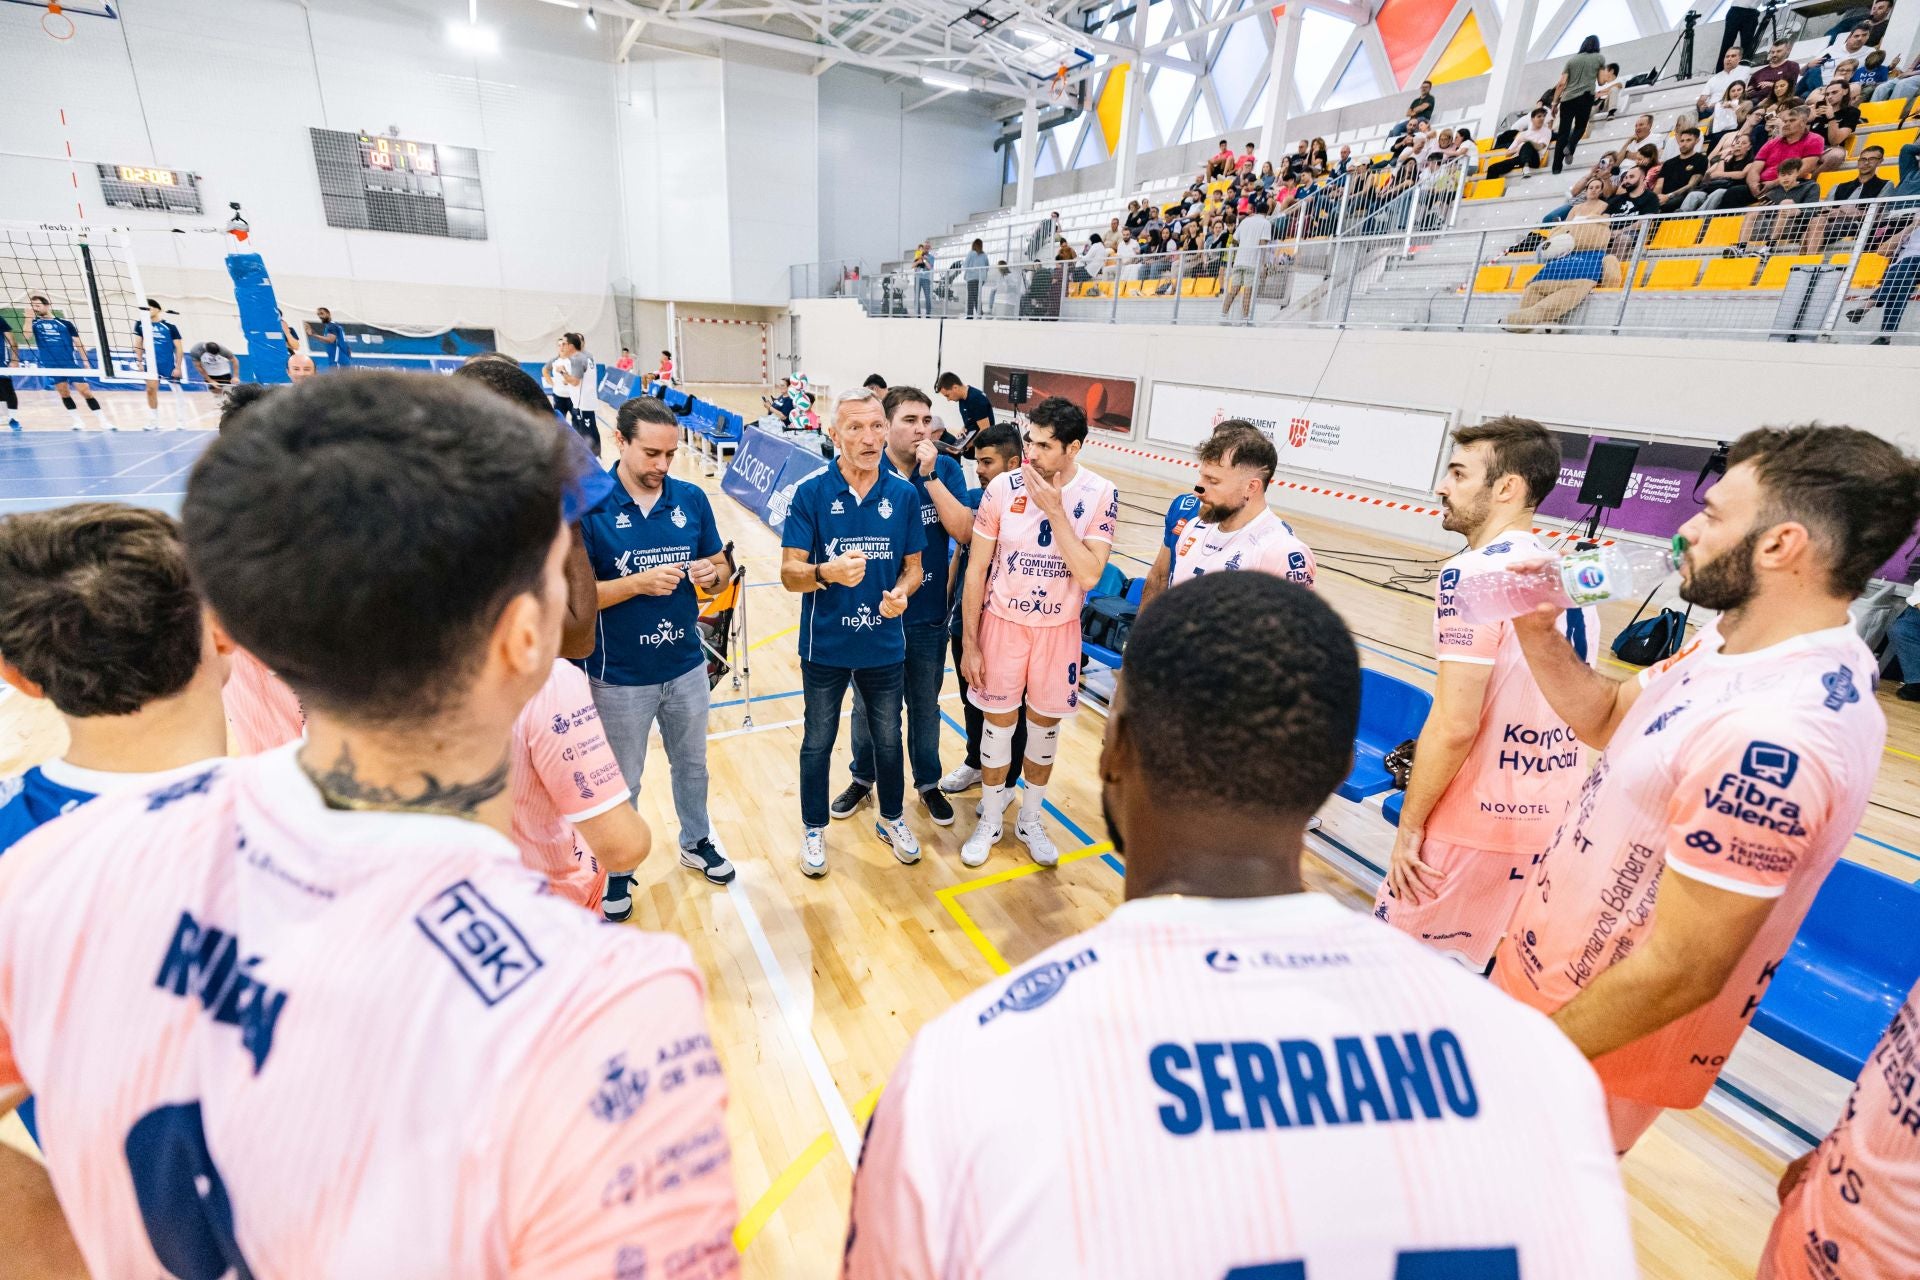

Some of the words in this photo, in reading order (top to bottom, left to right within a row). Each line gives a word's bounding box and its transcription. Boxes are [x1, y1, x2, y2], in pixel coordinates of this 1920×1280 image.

[732, 441, 775, 494] ASCIRES
[1641, 488, 1680, 500] Municipal
[1643, 482, 1680, 493] Esportiva
[1644, 476, 1681, 487] Fundació
[1038, 519, 1052, 547] 8
[633, 551, 691, 566] COMUNITAT
[840, 542, 891, 552] COMUNITAT
[1019, 557, 1067, 570] COMUNITA
[1022, 566, 1034, 576] DE
[1036, 569, 1073, 578] L'ESPOR
[1068, 662, 1077, 685] 8
[1503, 723, 1564, 750] Koryo
[1499, 746, 1579, 776] Hyundai
[1480, 802, 1550, 815] NOVOTEL
[1718, 773, 1802, 820] Fibra
[1704, 788, 1807, 837] Valencia
[1600, 841, 1655, 914] Barberá
[440, 893, 524, 987] TSK
[1564, 911, 1618, 990] Hermanos
[1148, 1028, 1480, 1137] SERRANO
